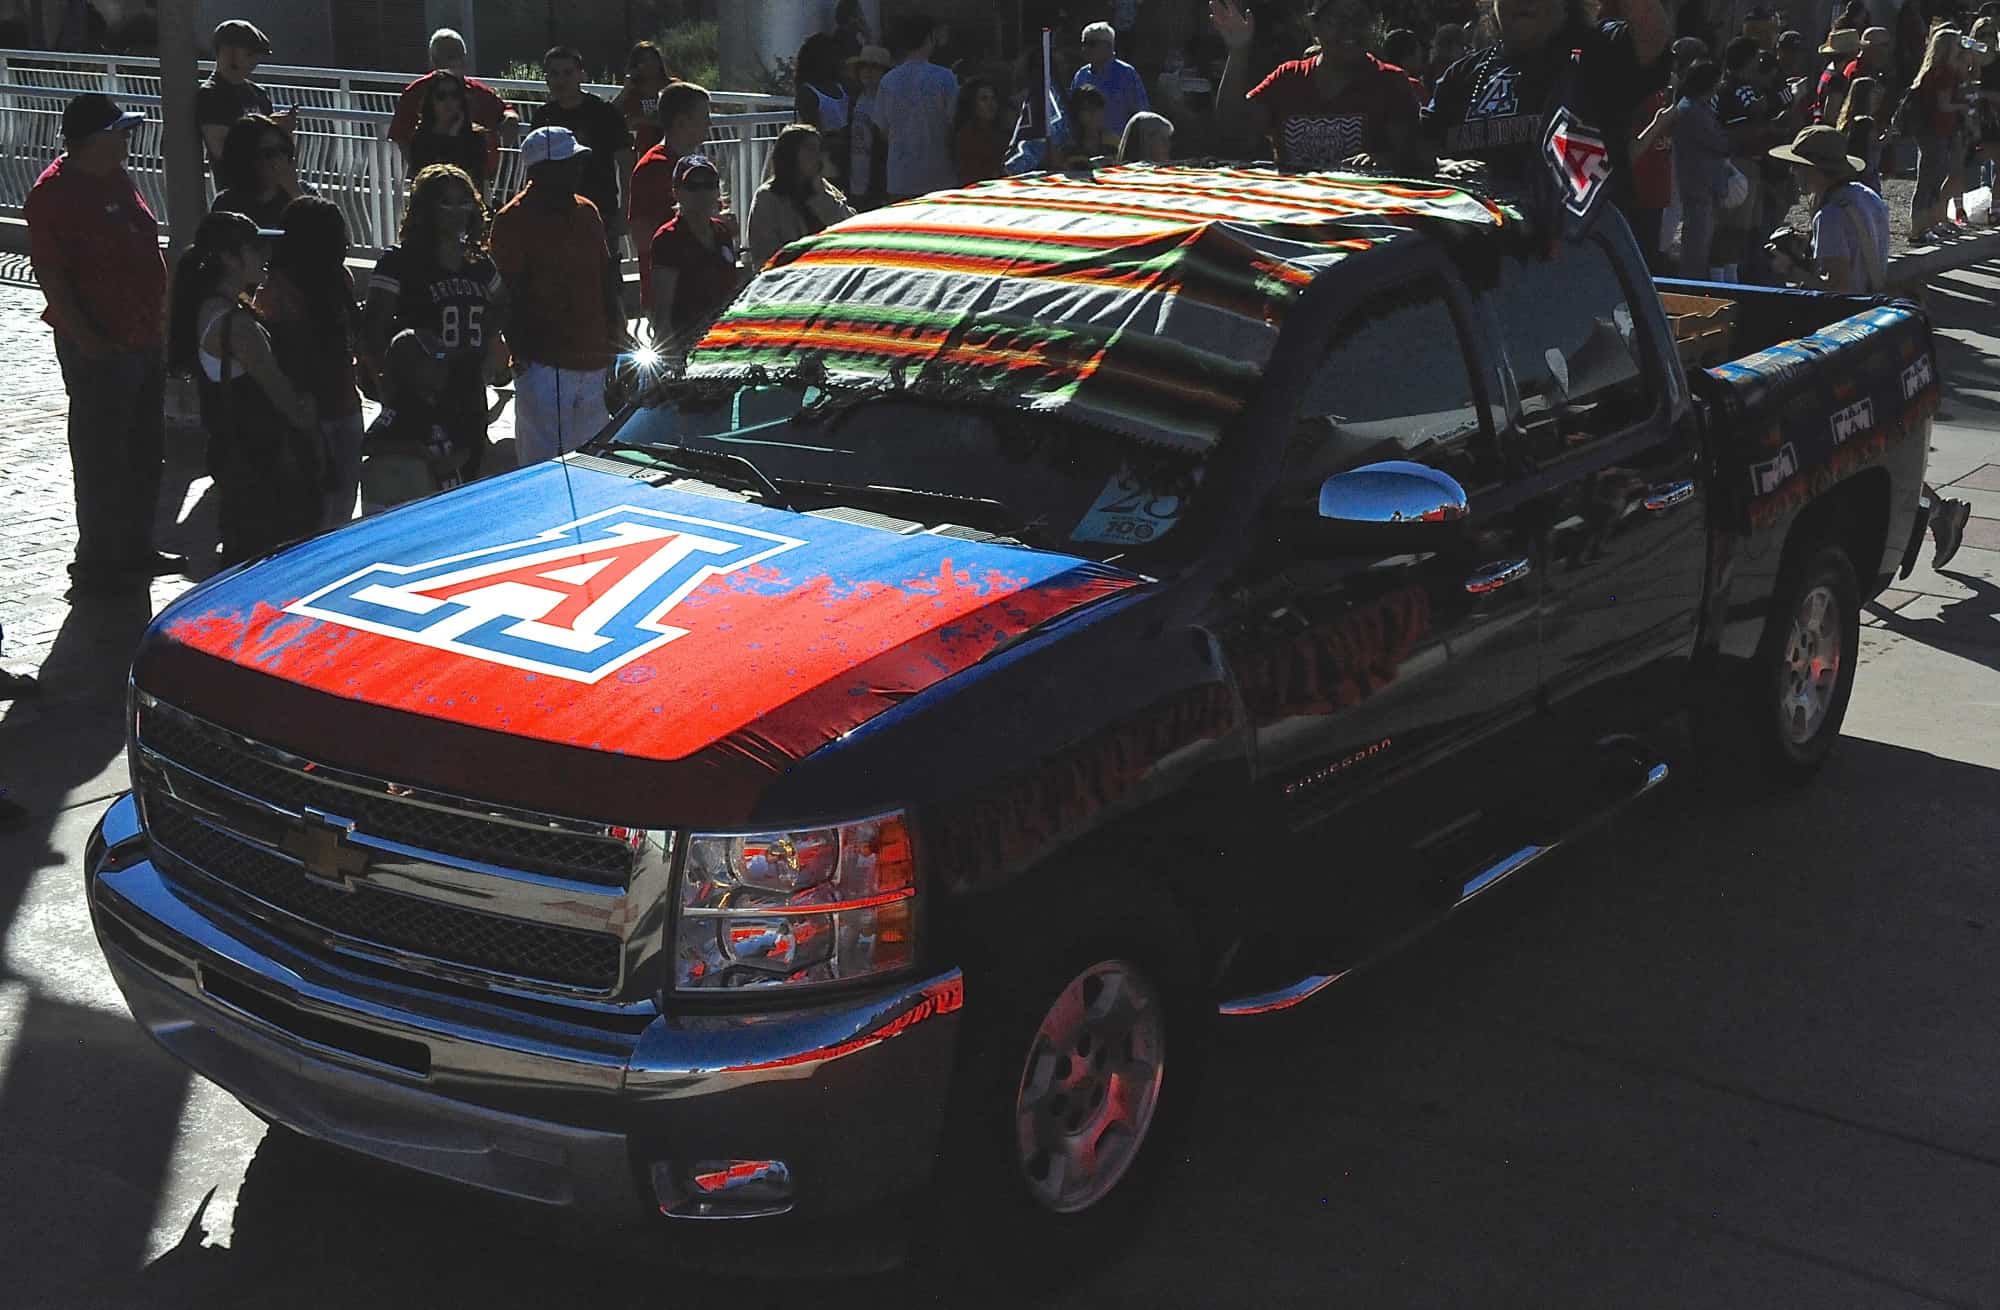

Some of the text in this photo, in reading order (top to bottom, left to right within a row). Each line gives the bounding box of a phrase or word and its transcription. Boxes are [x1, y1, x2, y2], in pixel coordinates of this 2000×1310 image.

[1545, 110, 1612, 211] A
[443, 305, 484, 347] 85
[292, 508, 800, 679] A
